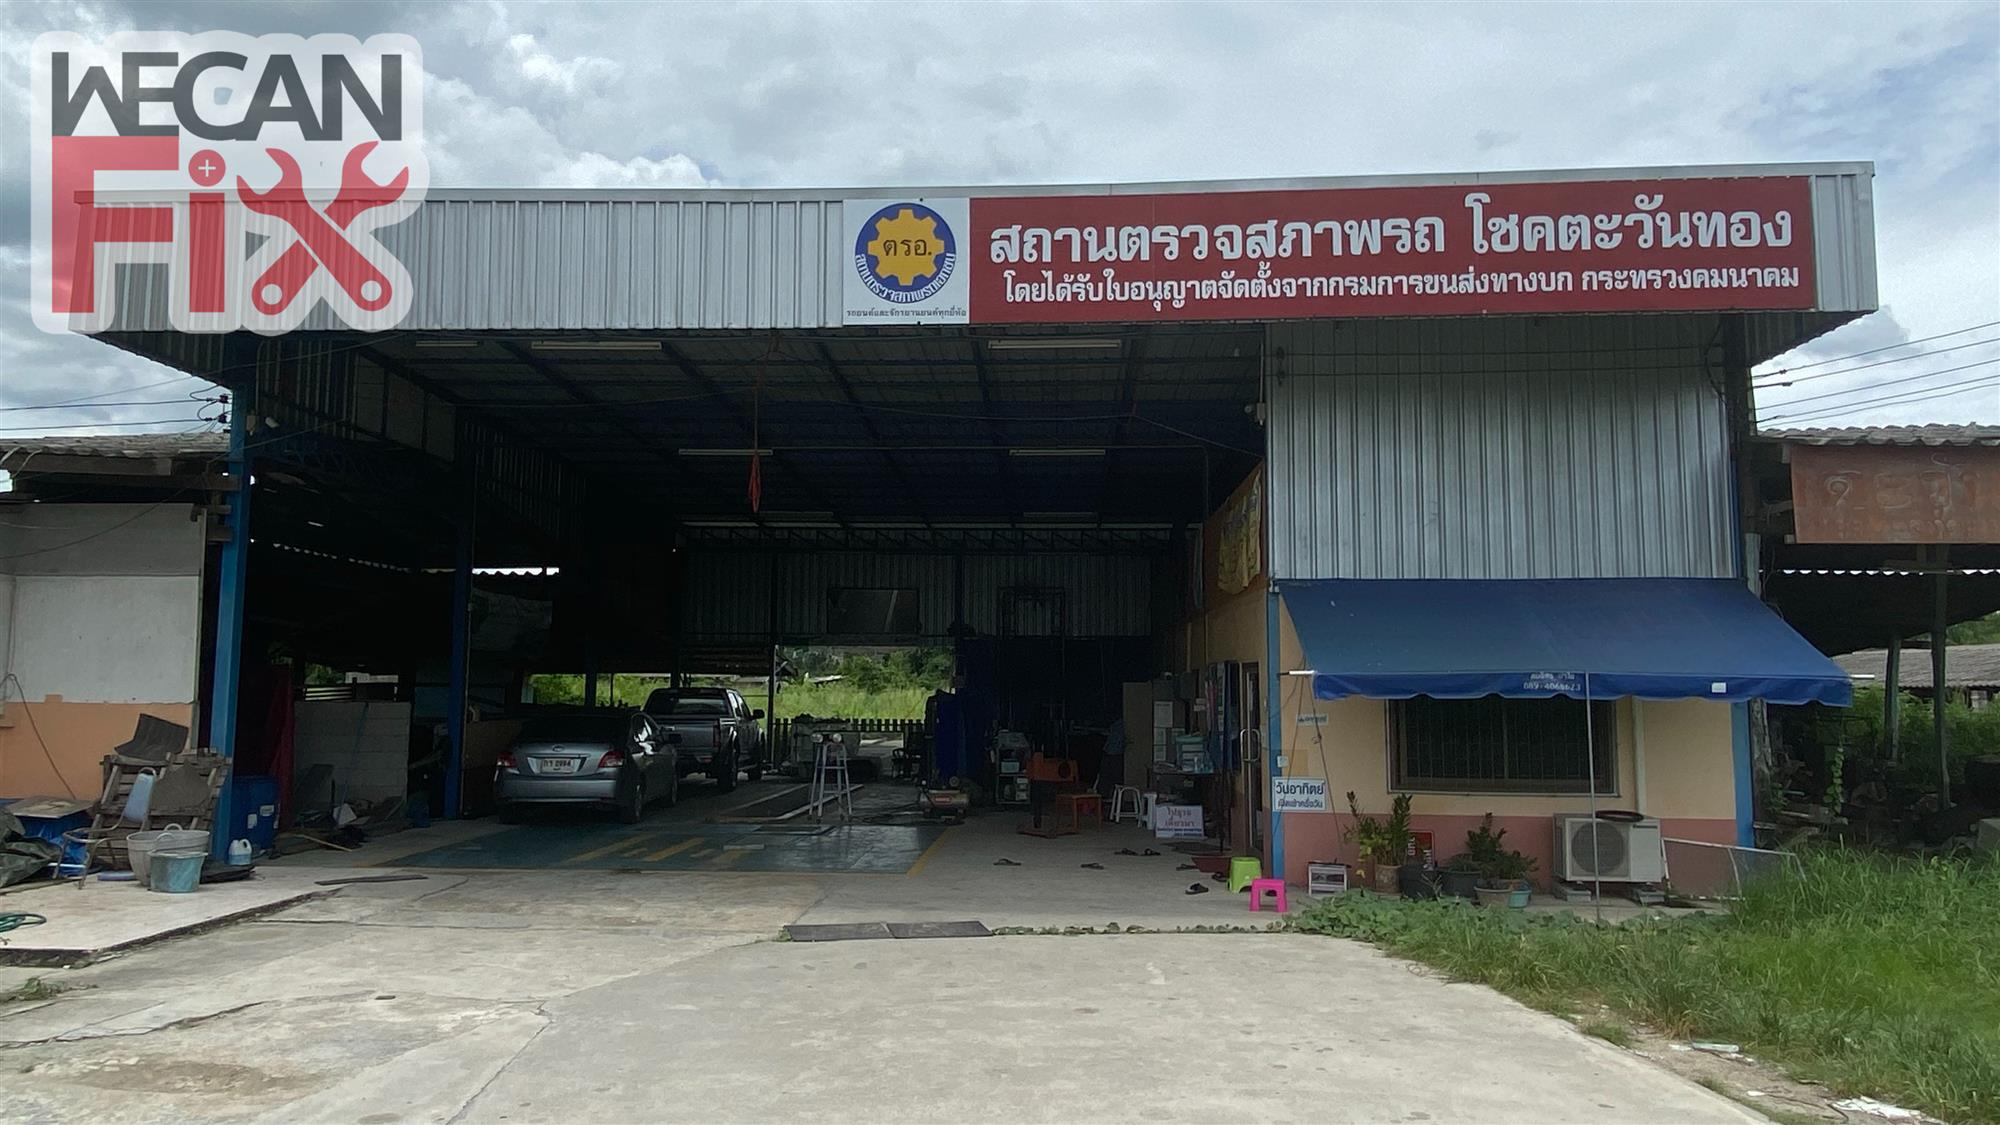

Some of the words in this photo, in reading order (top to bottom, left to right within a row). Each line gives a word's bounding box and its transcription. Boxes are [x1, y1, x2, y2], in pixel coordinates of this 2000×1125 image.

[990, 216, 1444, 263] สถานตรวจสภาพรถ
[1464, 193, 1792, 254] โชคตะวันทอง
[883, 239, 932, 256] ตรอ.
[1004, 262, 1573, 311] โดยได้รับใบอนุญาตจัดตั้งจากกรมการขนส่งทางบก
[1582, 265, 1799, 292] กระทรวงคมนาคม
[1276, 782, 1326, 795] วันอาทิตย์
